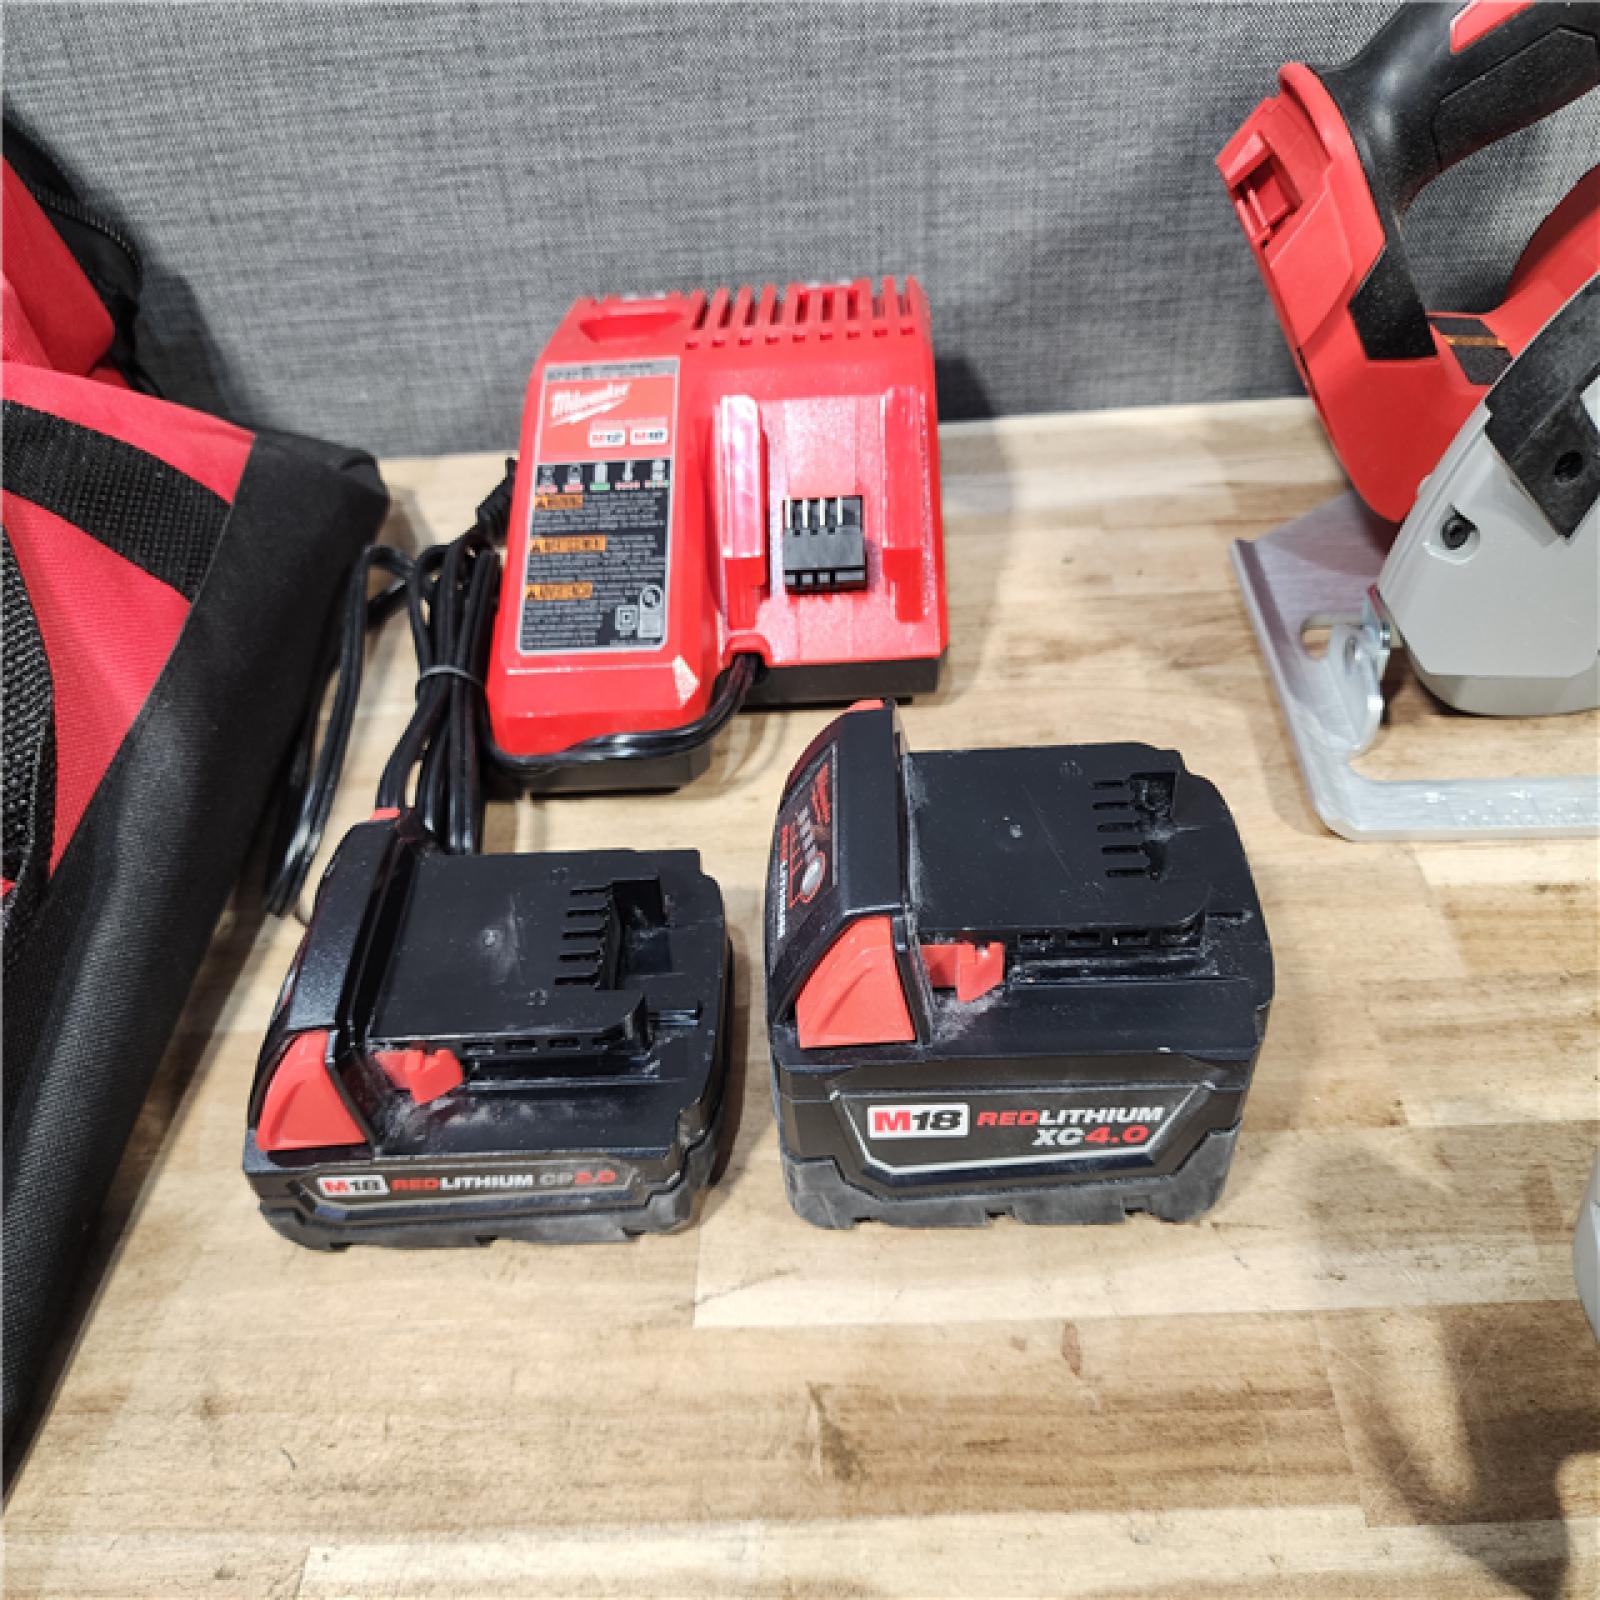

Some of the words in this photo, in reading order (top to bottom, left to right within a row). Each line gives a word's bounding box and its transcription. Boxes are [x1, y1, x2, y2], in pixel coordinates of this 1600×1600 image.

[874, 1109, 963, 1133] M18
[976, 1106, 1165, 1126] REDLITHIUM
[1031, 1124, 1149, 1146] XC4.0
[323, 1178, 379, 1192] M18
[391, 1174, 534, 1191] REDLITHIUM
